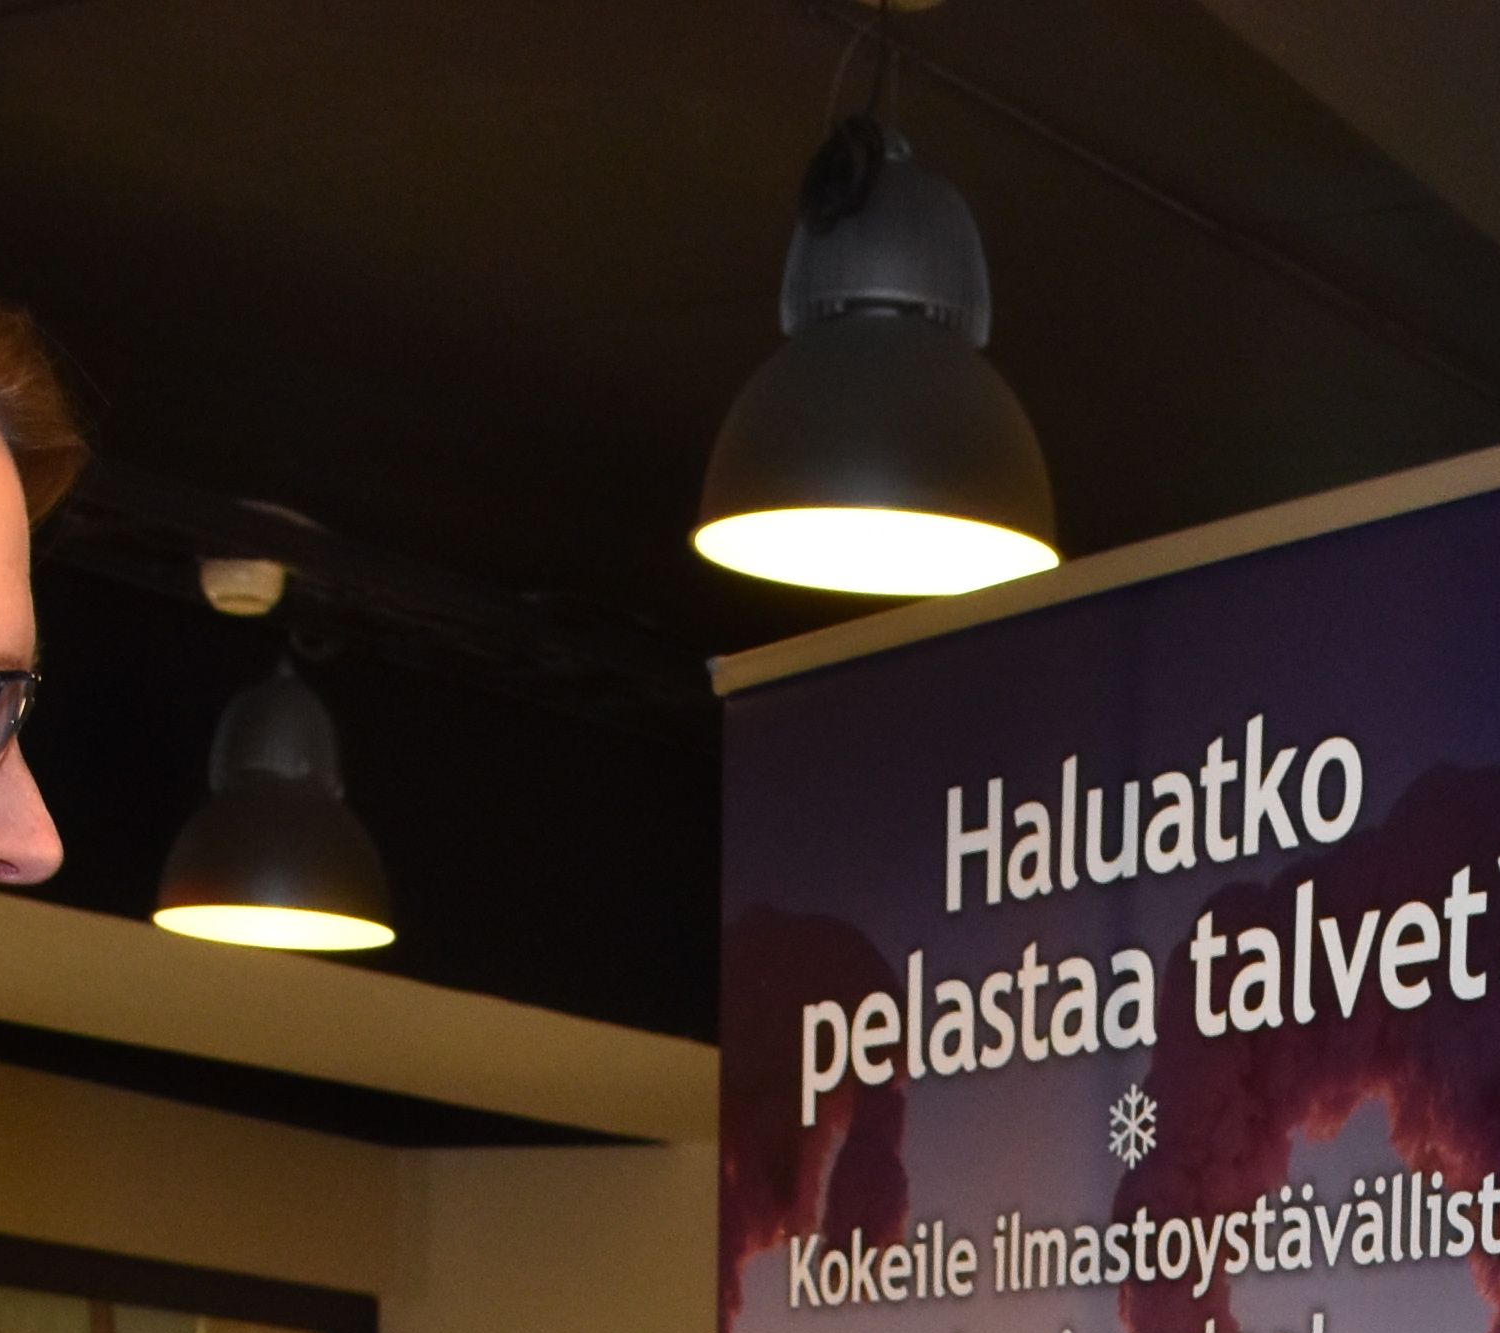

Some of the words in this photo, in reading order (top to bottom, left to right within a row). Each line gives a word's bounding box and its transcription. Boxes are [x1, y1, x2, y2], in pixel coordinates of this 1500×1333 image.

[945, 714, 1363, 912] Haluatko
[801, 941, 1156, 1125] pelastaa
[788, 1222, 976, 1307] Kokeile
